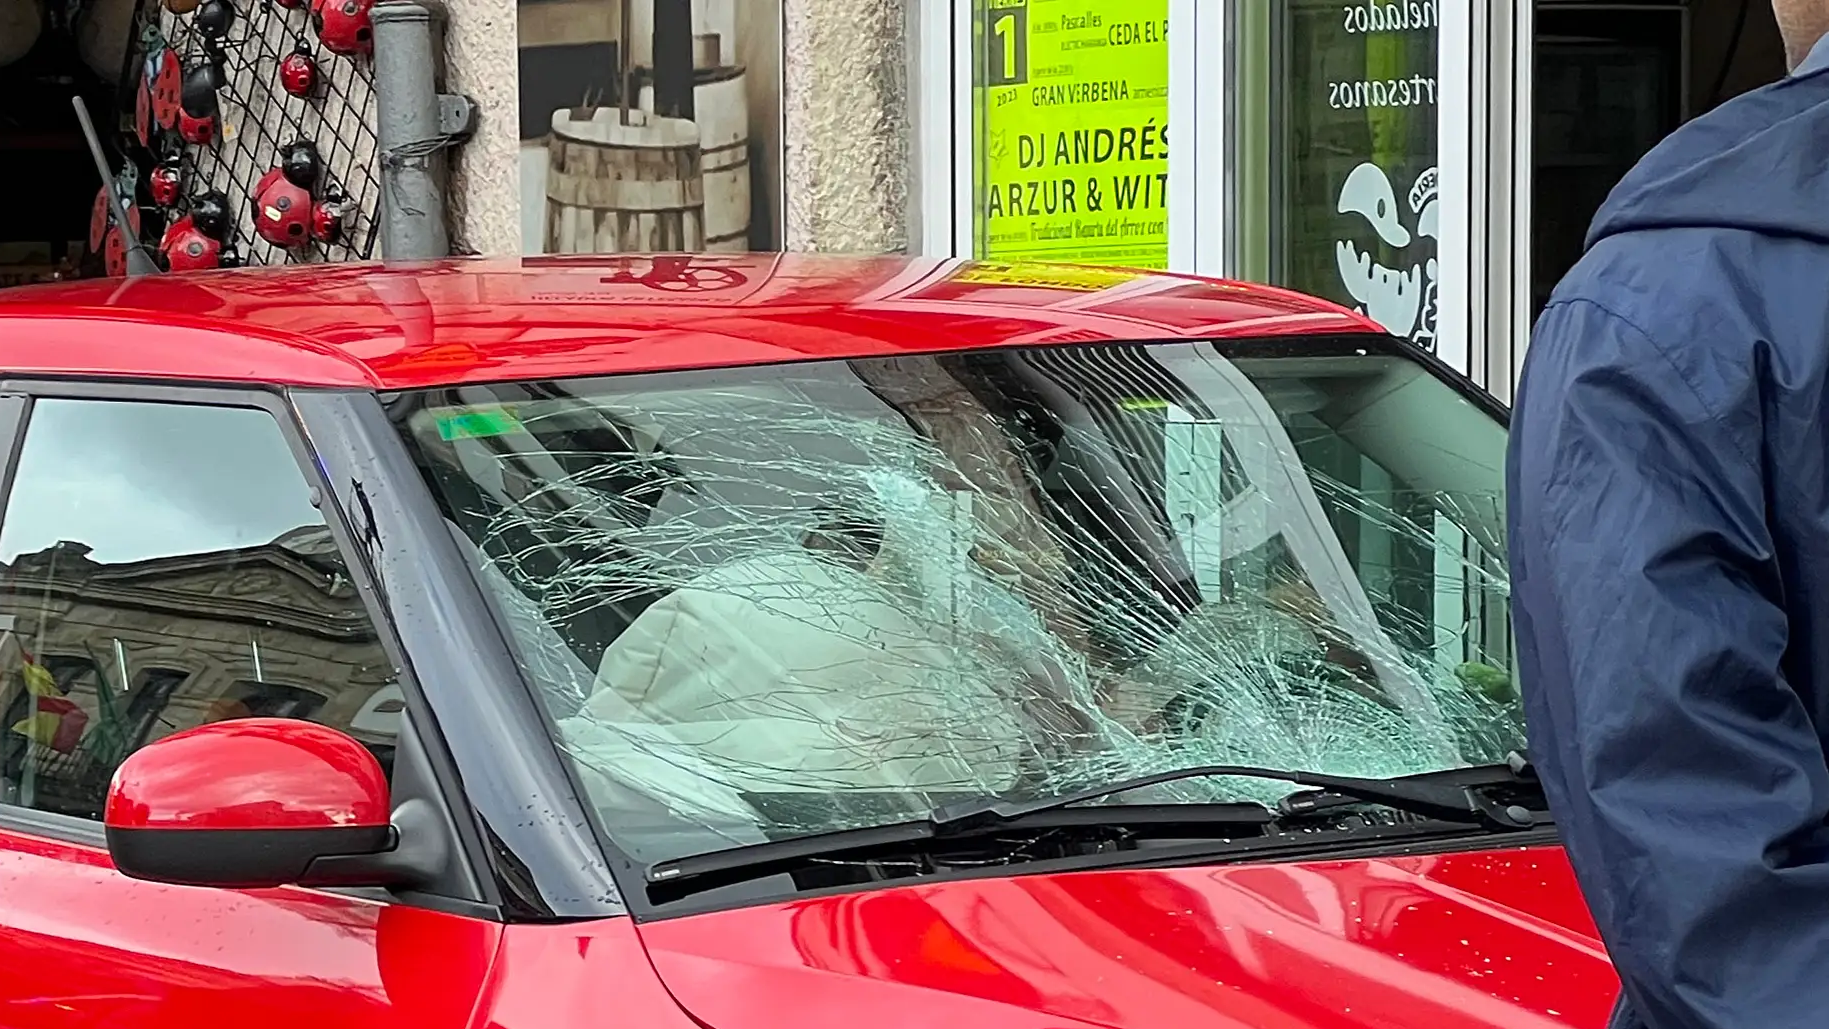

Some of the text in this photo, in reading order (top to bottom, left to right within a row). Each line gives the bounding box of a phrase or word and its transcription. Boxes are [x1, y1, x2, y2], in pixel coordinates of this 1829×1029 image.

[994, 14, 1016, 79] 1
[1108, 22, 1141, 46] CEDA
[1145, 21, 1159, 43] EL
[997, 88, 1018, 108] 2023
[1032, 86, 1066, 107] GRAN
[1069, 80, 1130, 105] VERBENA
[1019, 133, 1045, 169] DJ
[989, 178, 1076, 219] ARZUR
[1086, 177, 1103, 213] &
